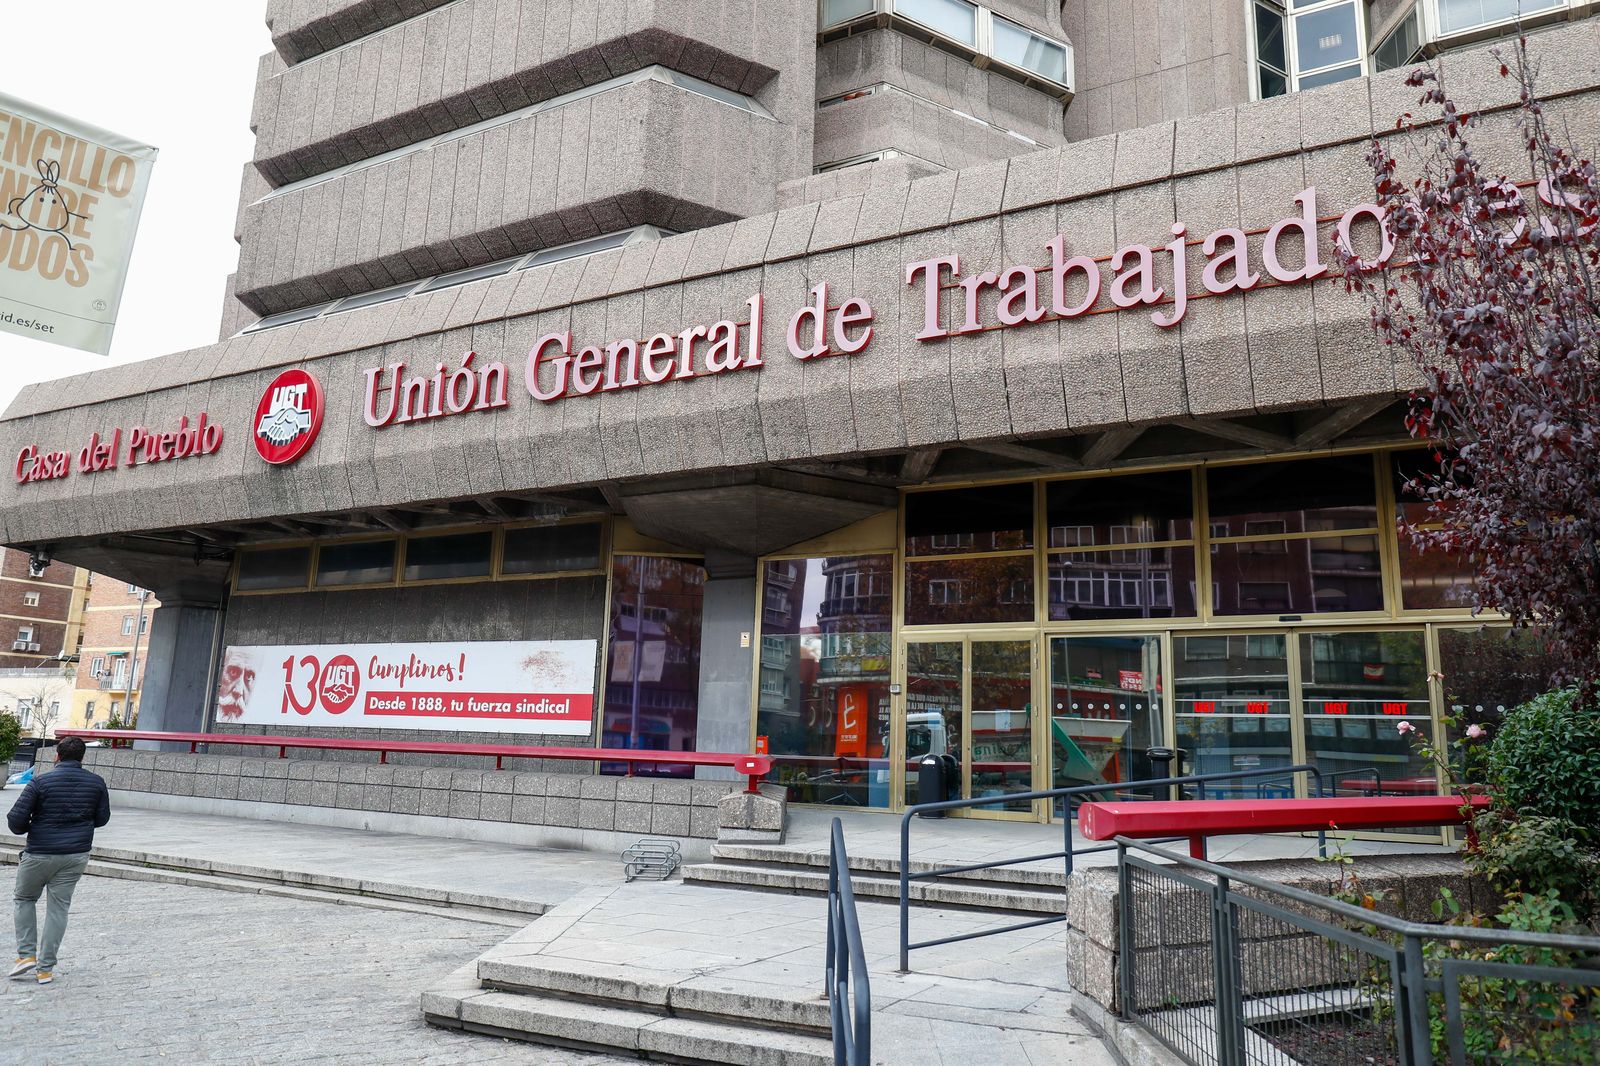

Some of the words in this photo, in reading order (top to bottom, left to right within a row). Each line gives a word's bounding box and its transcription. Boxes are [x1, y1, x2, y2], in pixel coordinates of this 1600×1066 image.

[0, 167, 98, 239] NTRE
[0, 311, 55, 334] id.es/set
[363, 350, 508, 428] Unión
[524, 293, 764, 401] General
[786, 281, 875, 360] de
[269, 383, 308, 411] UGT
[14, 444, 70, 484] Casa
[77, 427, 122, 473] del
[125, 411, 224, 467] Pueblo
[327, 665, 356, 685] UGT
[368, 653, 465, 688] Cumplimos!
[369, 696, 406, 710] Desde
[411, 697, 446, 713] 1888,
[451, 699, 464, 711] tu
[467, 697, 511, 713] fuerza
[515, 698, 570, 714] sindical
[1193, 702, 1216, 713] UGT
[1247, 702, 1269, 713] UGT
[1324, 702, 1348, 714] UGT
[1382, 703, 1408, 714] UGT
